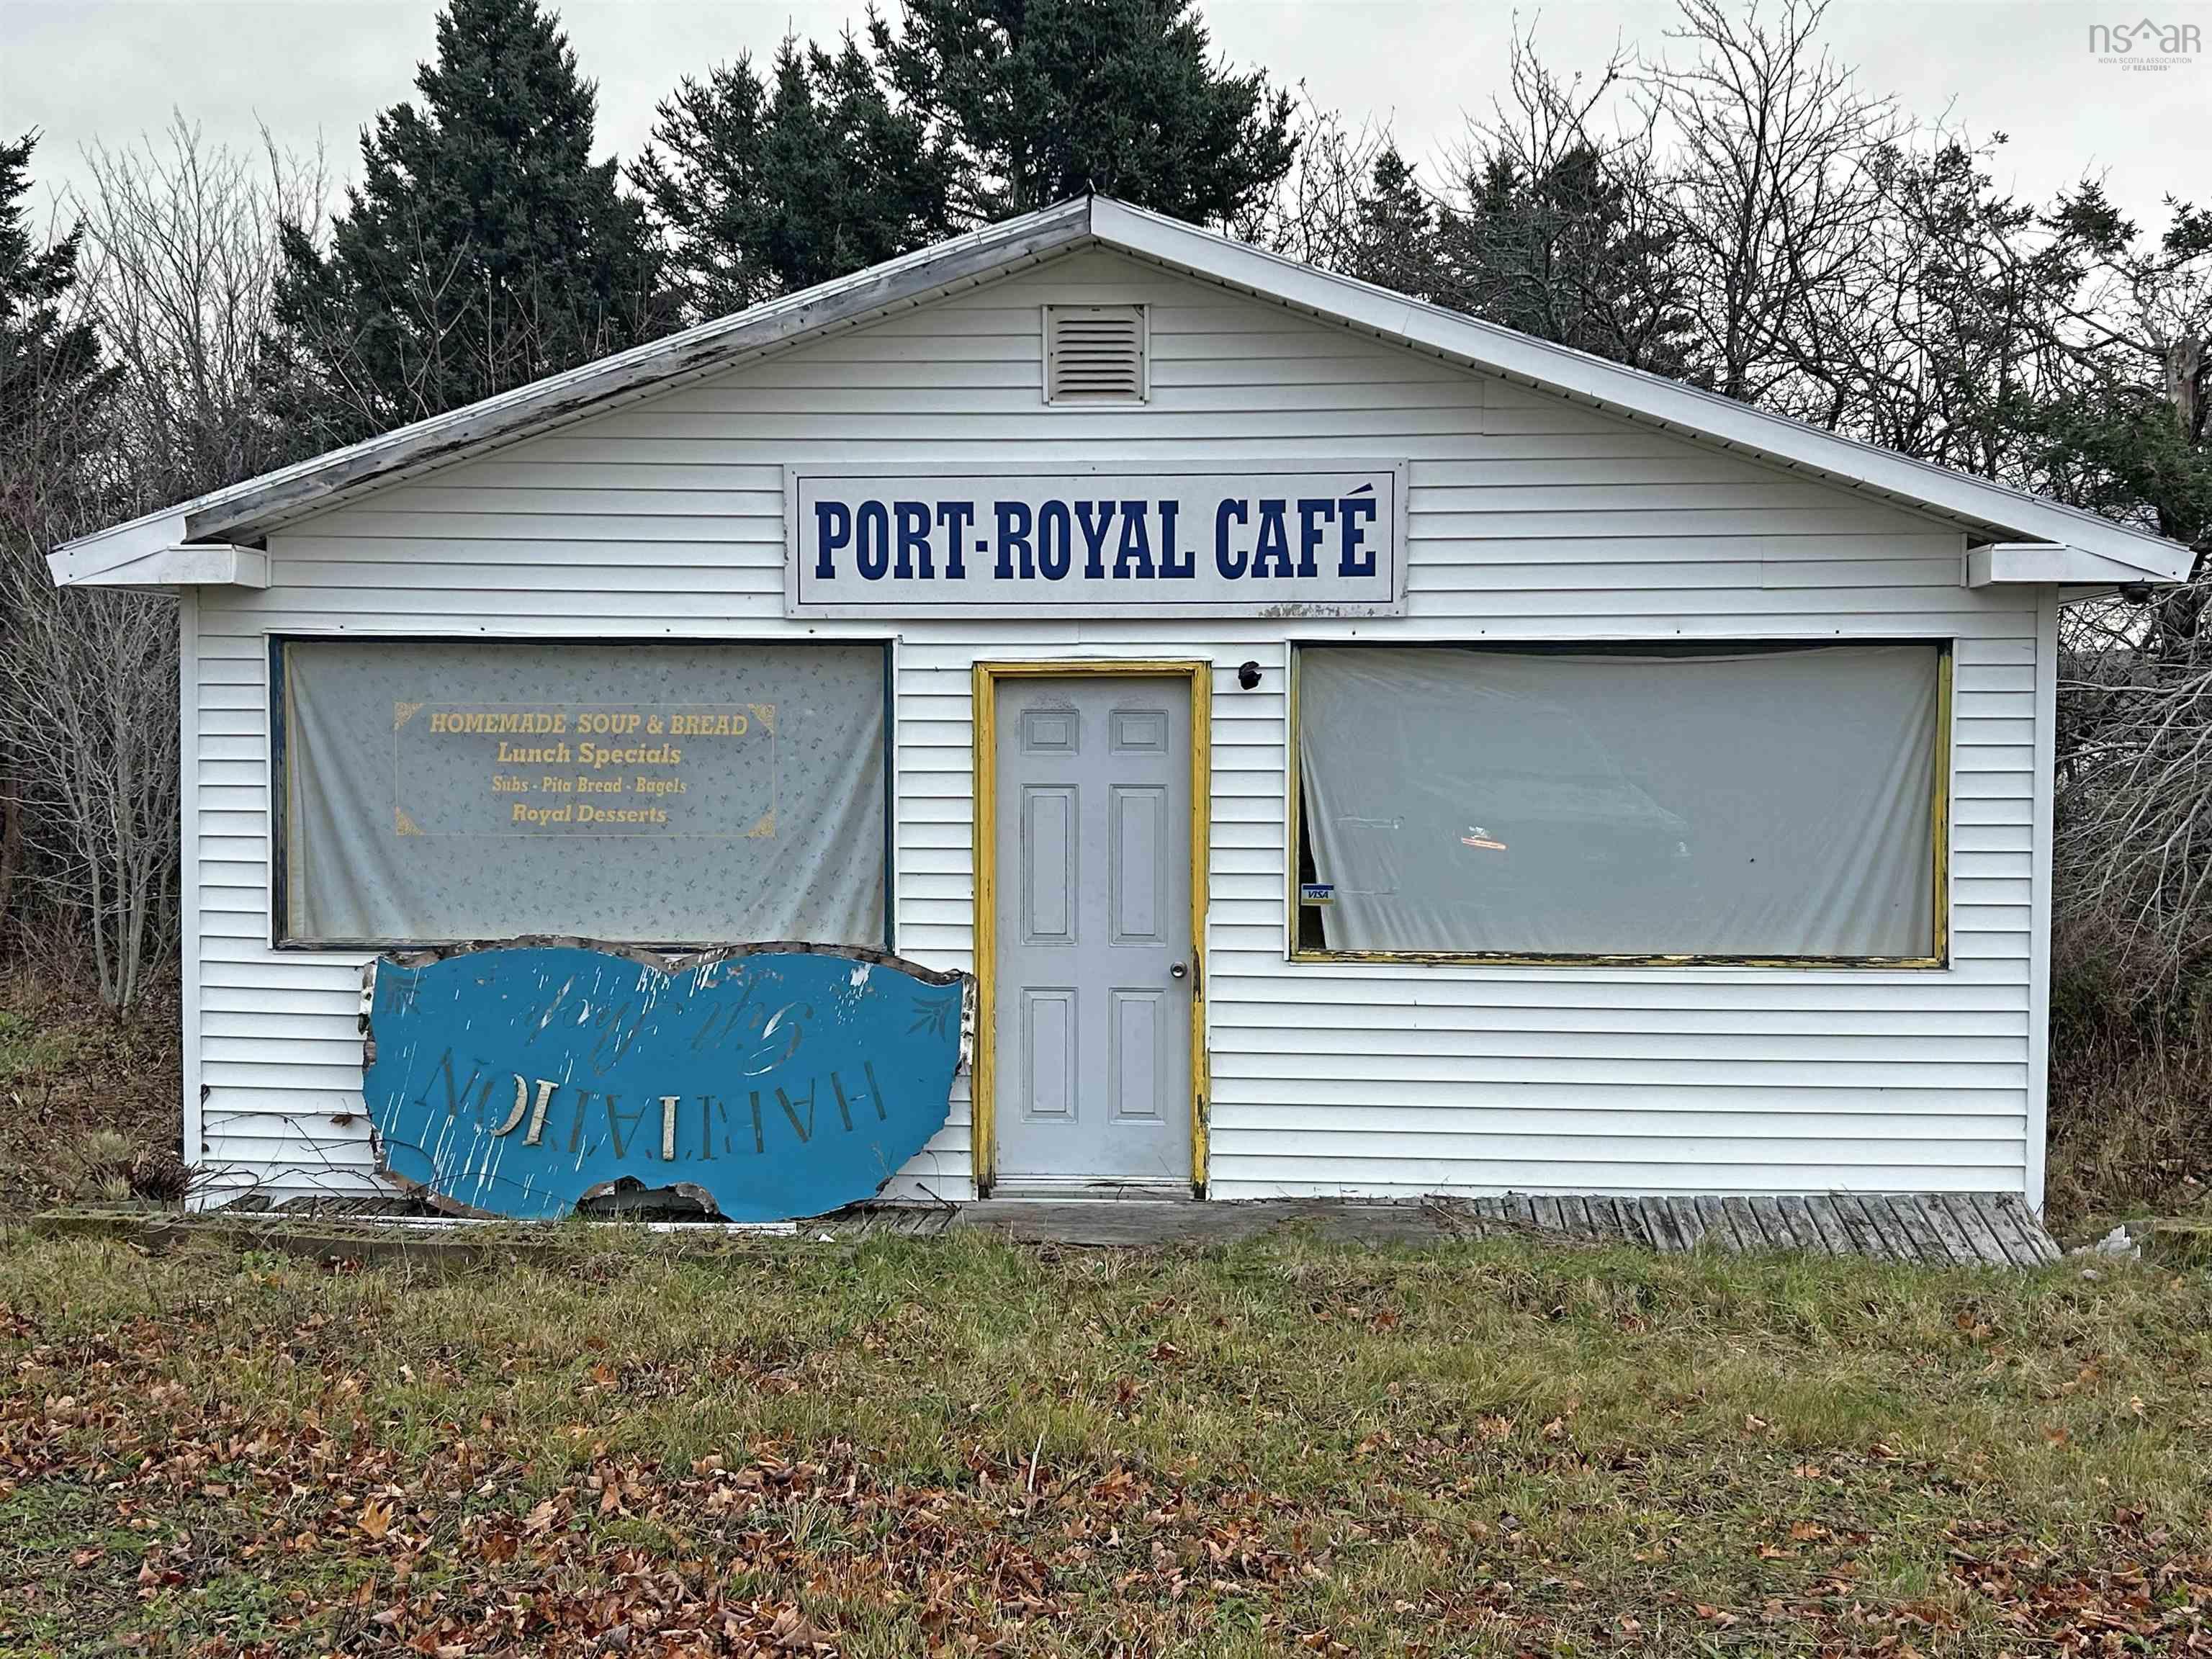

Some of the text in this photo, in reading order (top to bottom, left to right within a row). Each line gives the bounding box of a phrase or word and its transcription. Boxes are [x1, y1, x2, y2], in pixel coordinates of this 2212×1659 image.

[814, 482, 1377, 581] PORT-ROYAL CAFÉ
[430, 713, 749, 736] HOMEMADE SOUP & BREAD
[496, 742, 682, 769] Lunch Specials
[492, 775, 529, 793] Subs
[541, 775, 572, 793] Pita
[577, 776, 622, 793] Bread
[635, 778, 688, 796] Bagels
[512, 803, 667, 826] Royal Desserts
[1308, 890, 1328, 899] VISA
